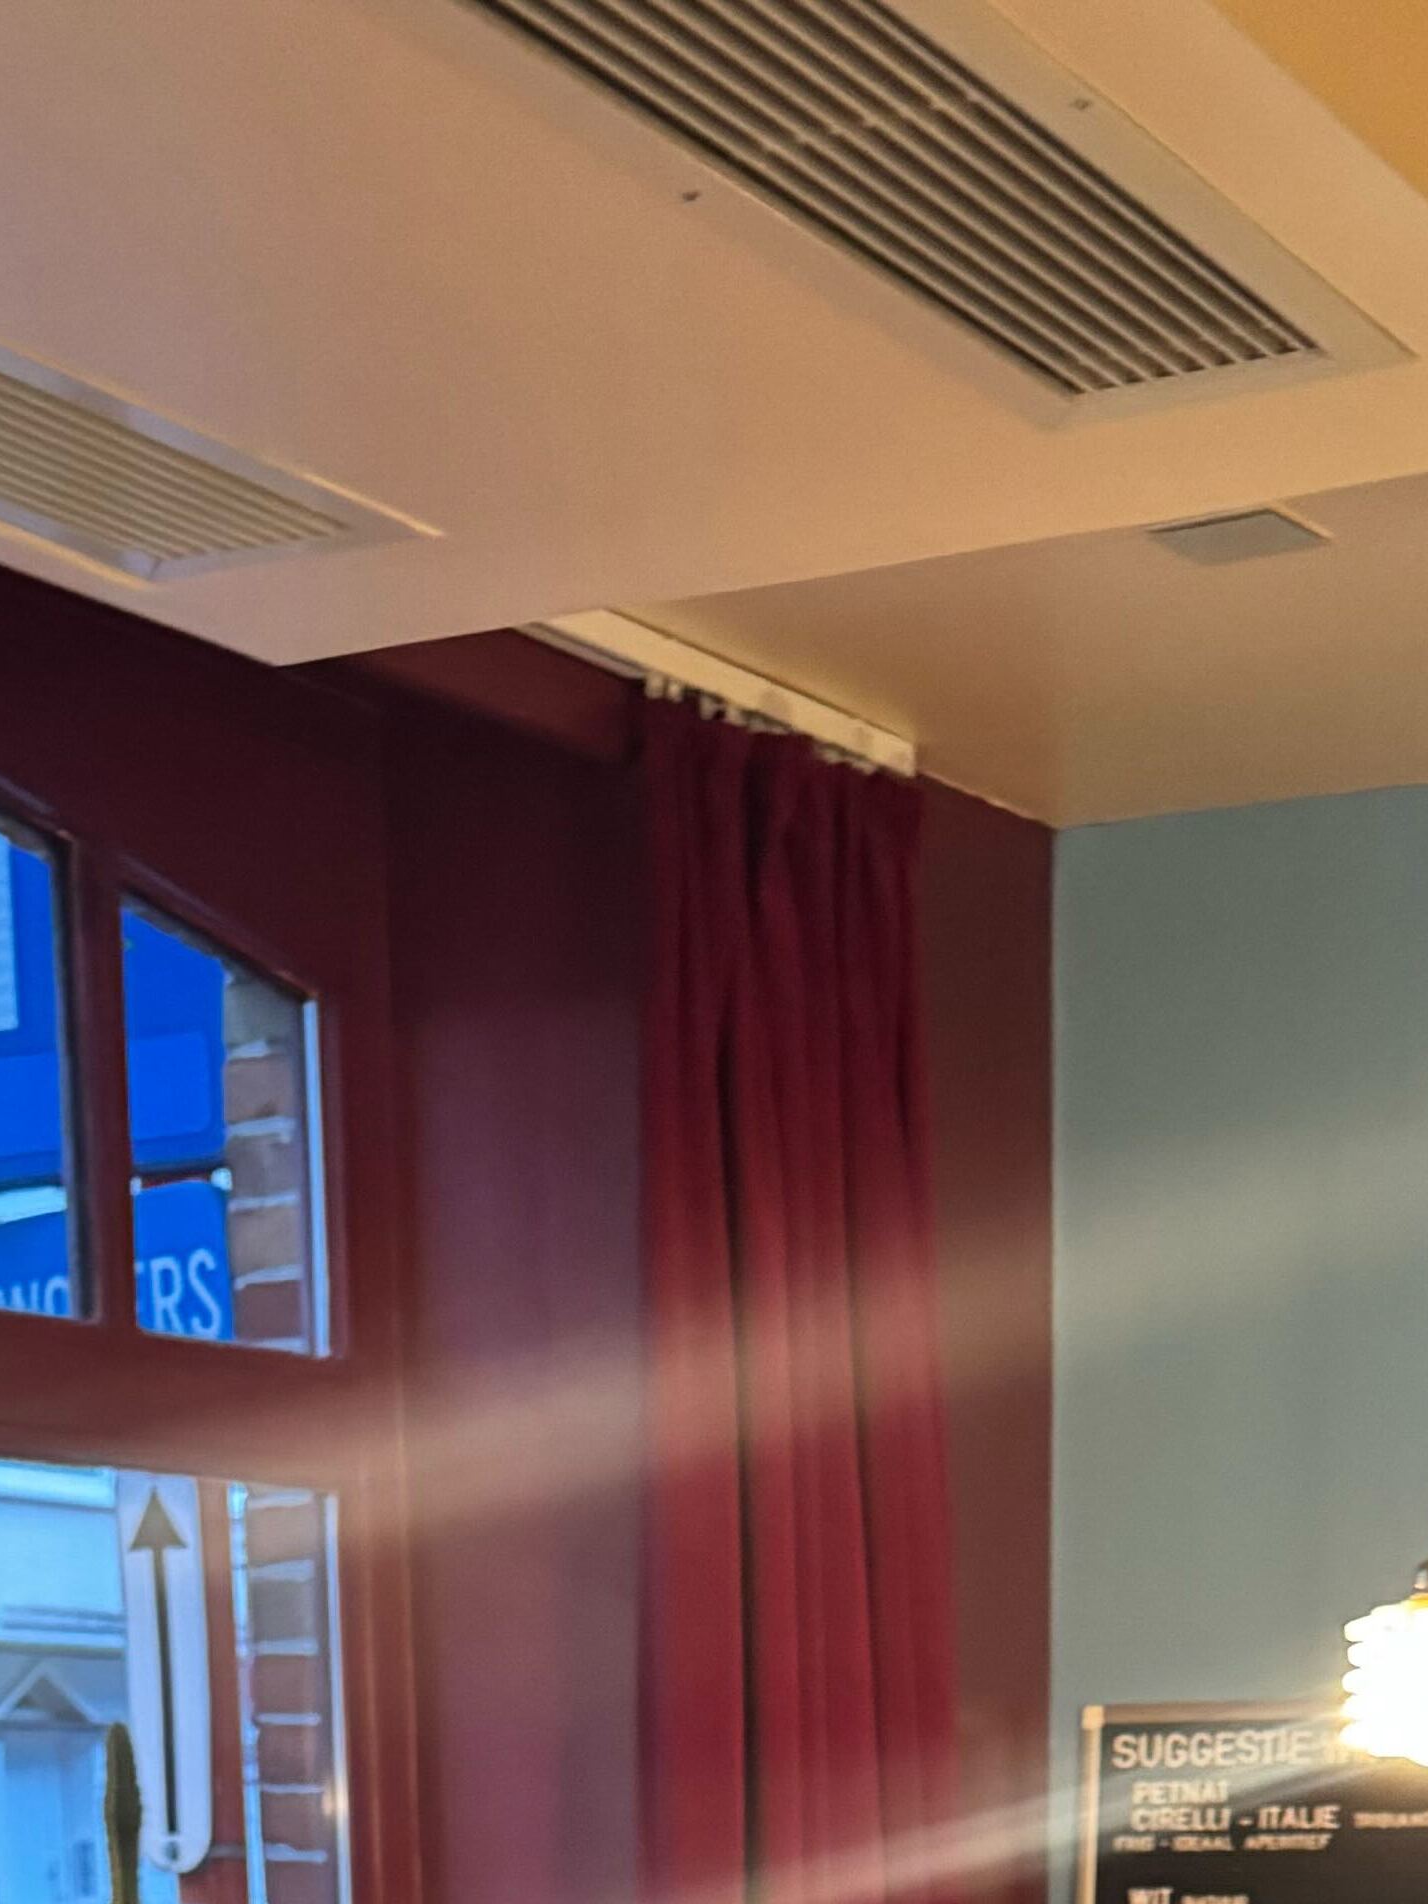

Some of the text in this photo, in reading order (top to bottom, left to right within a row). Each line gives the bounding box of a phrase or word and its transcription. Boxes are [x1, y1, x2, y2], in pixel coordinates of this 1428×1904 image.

[1112, 1730, 1315, 1768] SUGGESTIE
[1130, 1807, 1232, 1831] CIRELLI
[1258, 1805, 1341, 1829] ITALIE
